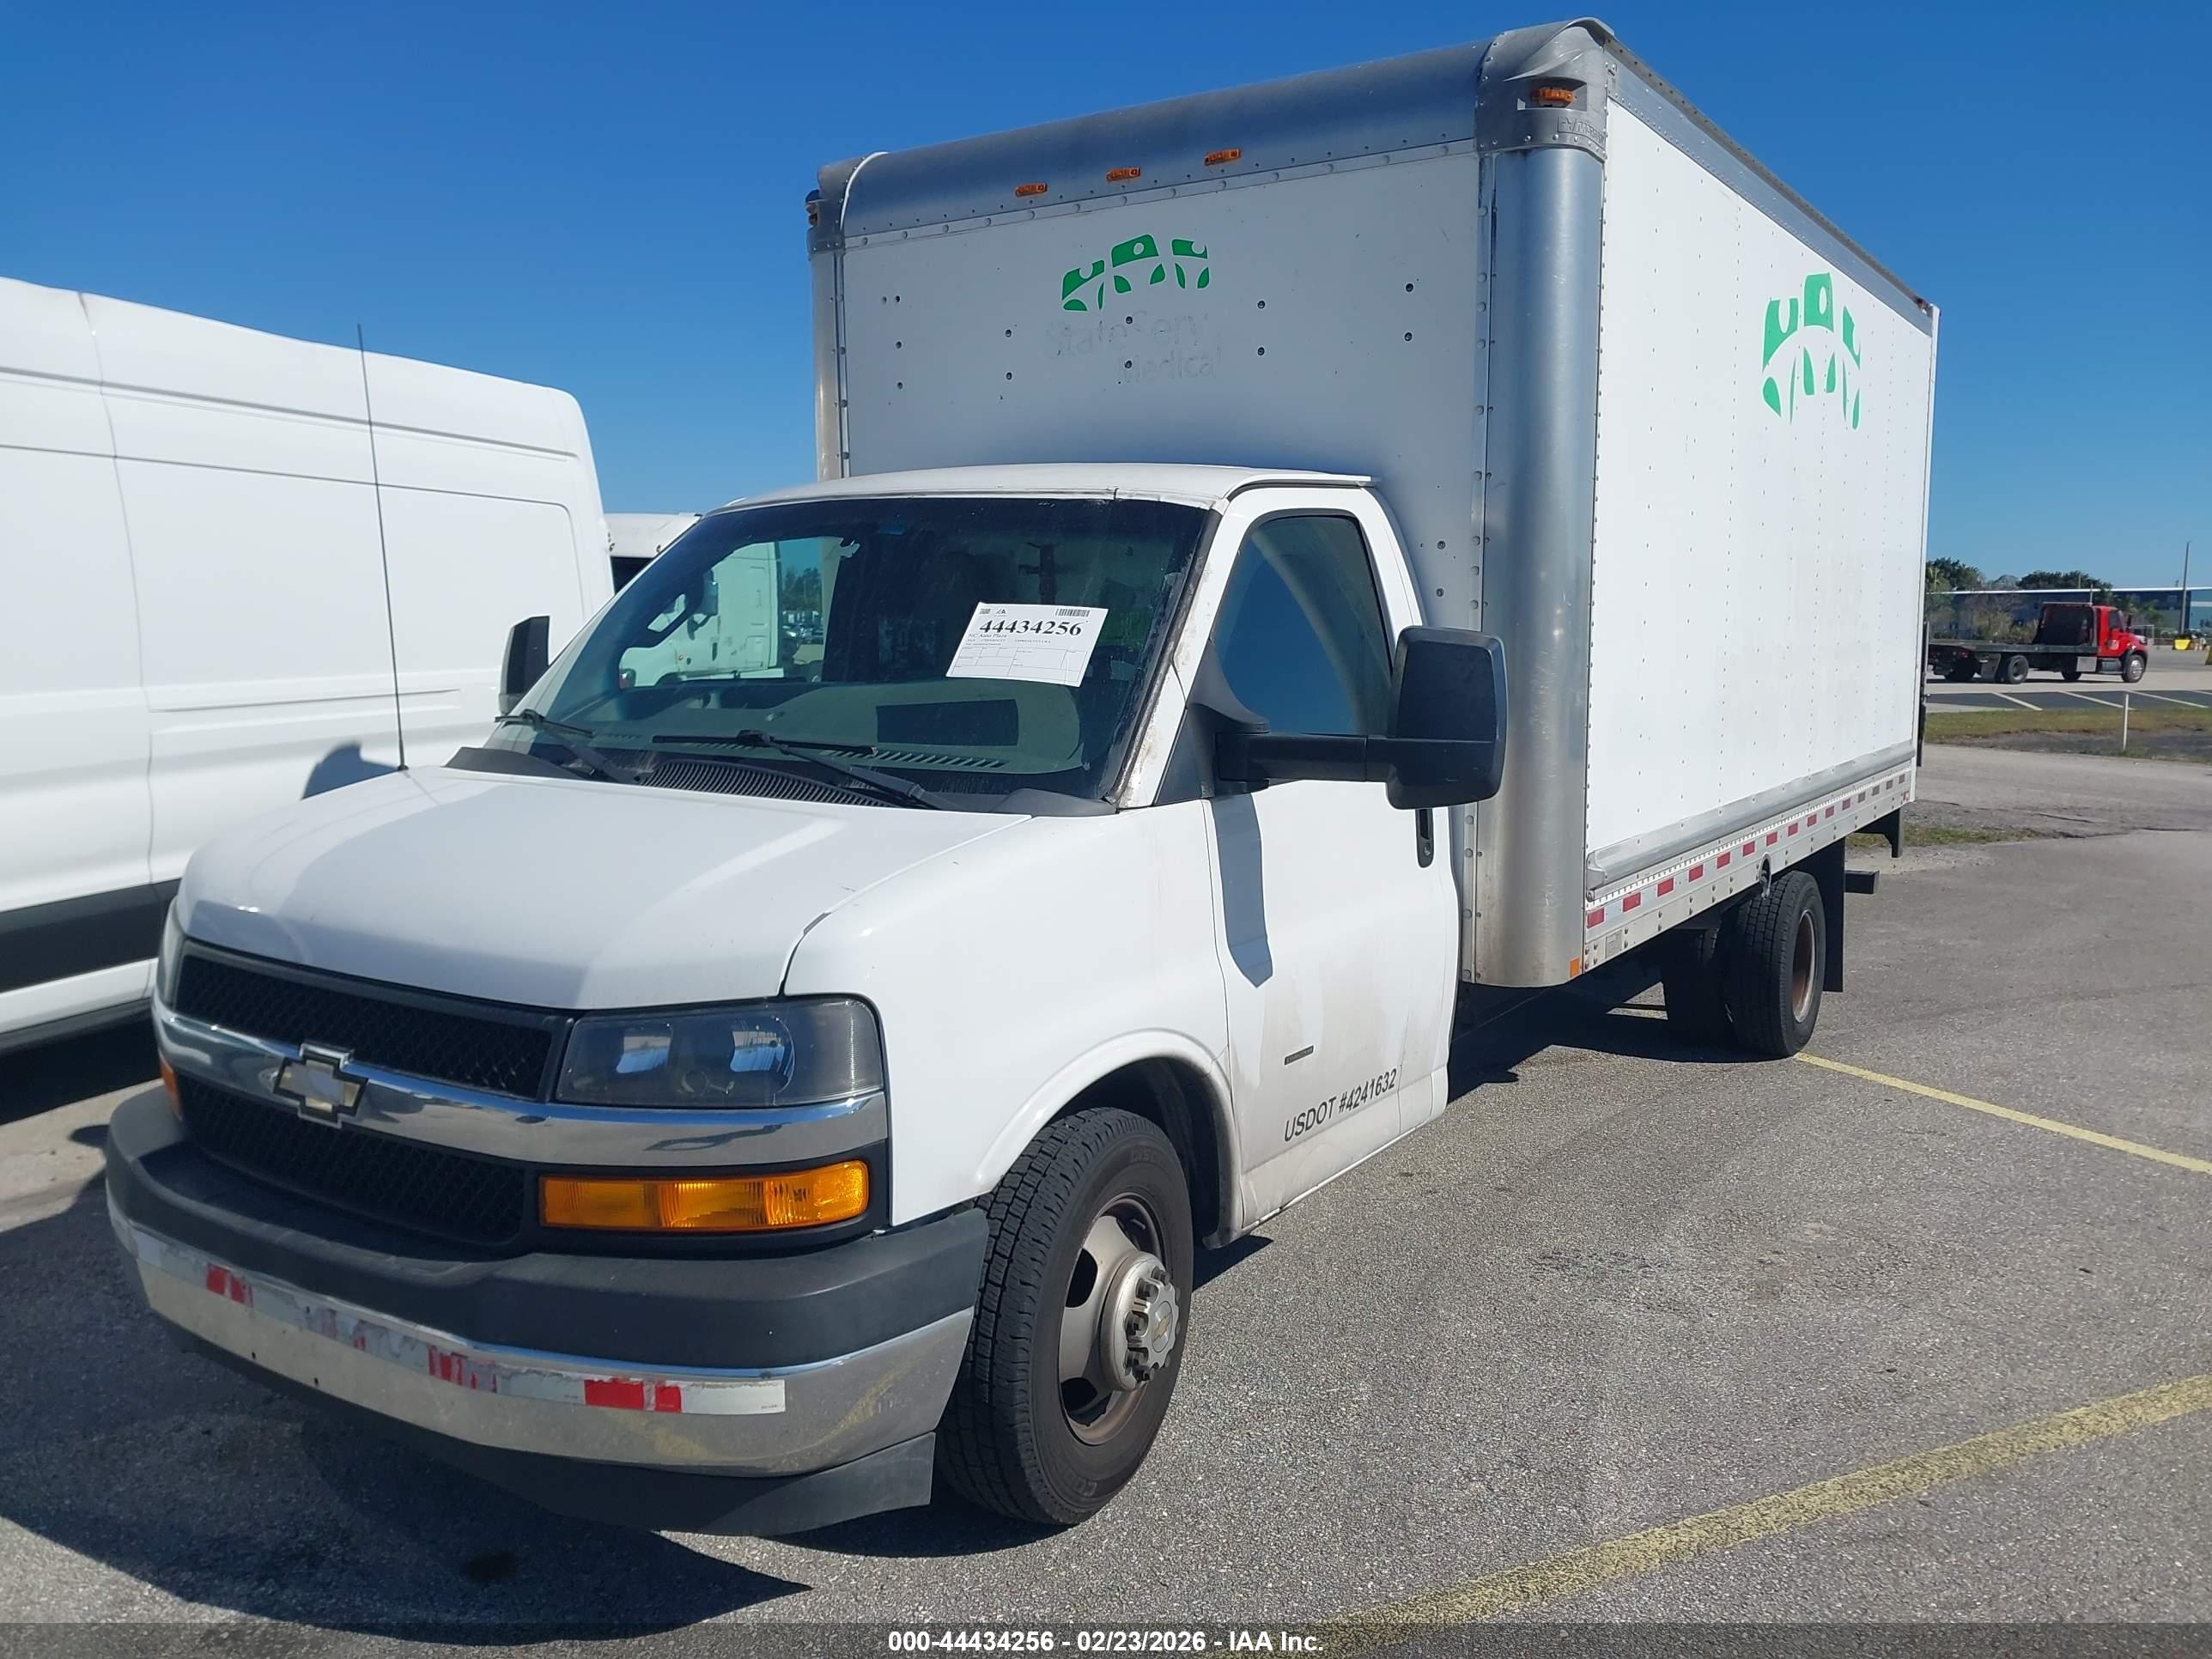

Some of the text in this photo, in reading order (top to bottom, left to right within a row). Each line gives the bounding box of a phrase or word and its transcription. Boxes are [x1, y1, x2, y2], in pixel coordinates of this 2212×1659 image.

[979, 619, 1085, 636] 44434256
[1284, 1067, 1397, 1142] USDOT #4241632
